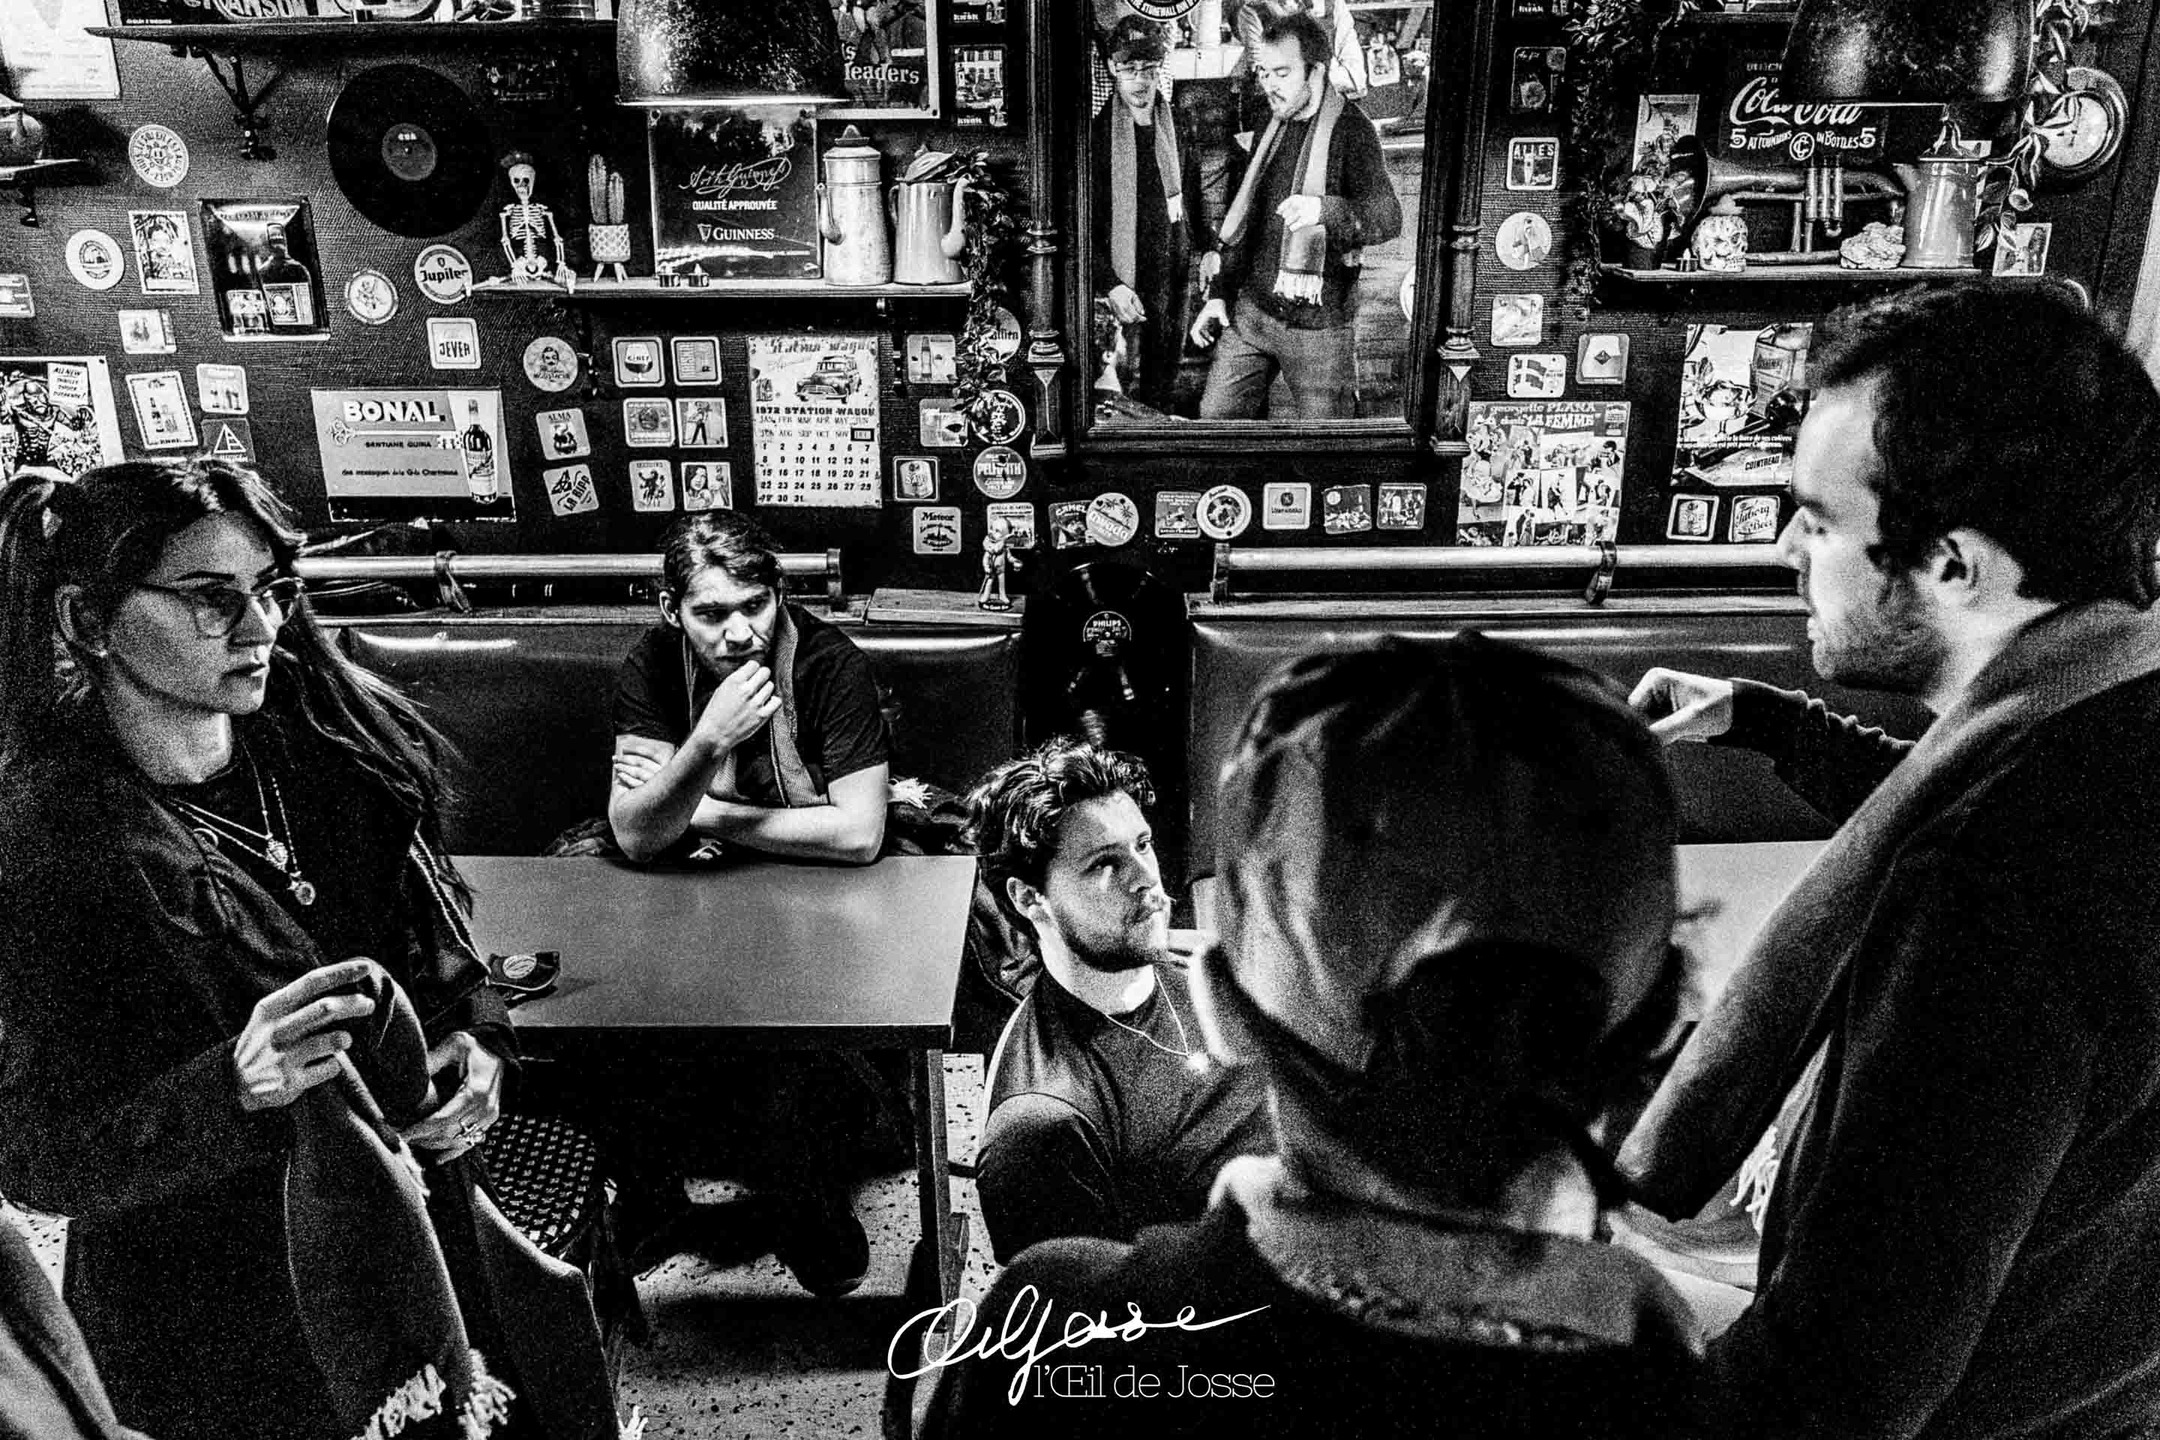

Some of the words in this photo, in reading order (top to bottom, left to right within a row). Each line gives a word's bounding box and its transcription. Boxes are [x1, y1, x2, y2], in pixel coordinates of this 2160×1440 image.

[844, 62, 920, 85] leaders
[692, 199, 727, 210] QUALITÉ
[728, 198, 778, 210] APPROUVÉE
[713, 227, 775, 240] GUINNESS
[420, 268, 468, 284] Jupiler
[439, 341, 470, 358] JEVER
[343, 400, 445, 422] BONAL
[785, 407, 833, 415] STATION
[836, 407, 876, 416] WAGON
[1490, 403, 1544, 417] georgette
[1547, 402, 1596, 412] PLANA
[763, 442, 767, 450] 1
[780, 442, 785, 451] 2
[797, 443, 803, 451] 3
[812, 443, 817, 451] 4
[829, 443, 835, 452] 5
[847, 443, 853, 452] 6
[864, 443, 870, 452] 7
[762, 455, 768, 464] 8
[780, 455, 786, 464] 9
[795, 456, 806, 465] 10
[811, 456, 820, 464] 11
[827, 456, 837, 465] 12
[843, 456, 853, 465] 13
[860, 457, 870, 465] 14
[762, 468, 773, 477] 15
[779, 468, 789, 477] 16
[795, 469, 805, 477] 17
[811, 469, 821, 477] 18
[827, 469, 837, 478] 19
[842, 469, 854, 478] 20
[859, 470, 870, 479] 21
[760, 480, 772, 490] 22
[777, 481, 788, 490] 23
[794, 481, 805, 490] 24
[810, 482, 822, 490] 25
[844, 482, 855, 491] 27
[777, 494, 788, 503] 30
[793, 494, 804, 503] 31
[1056, 504, 1087, 516] CAMEL
[921, 512, 955, 521] Meteor
